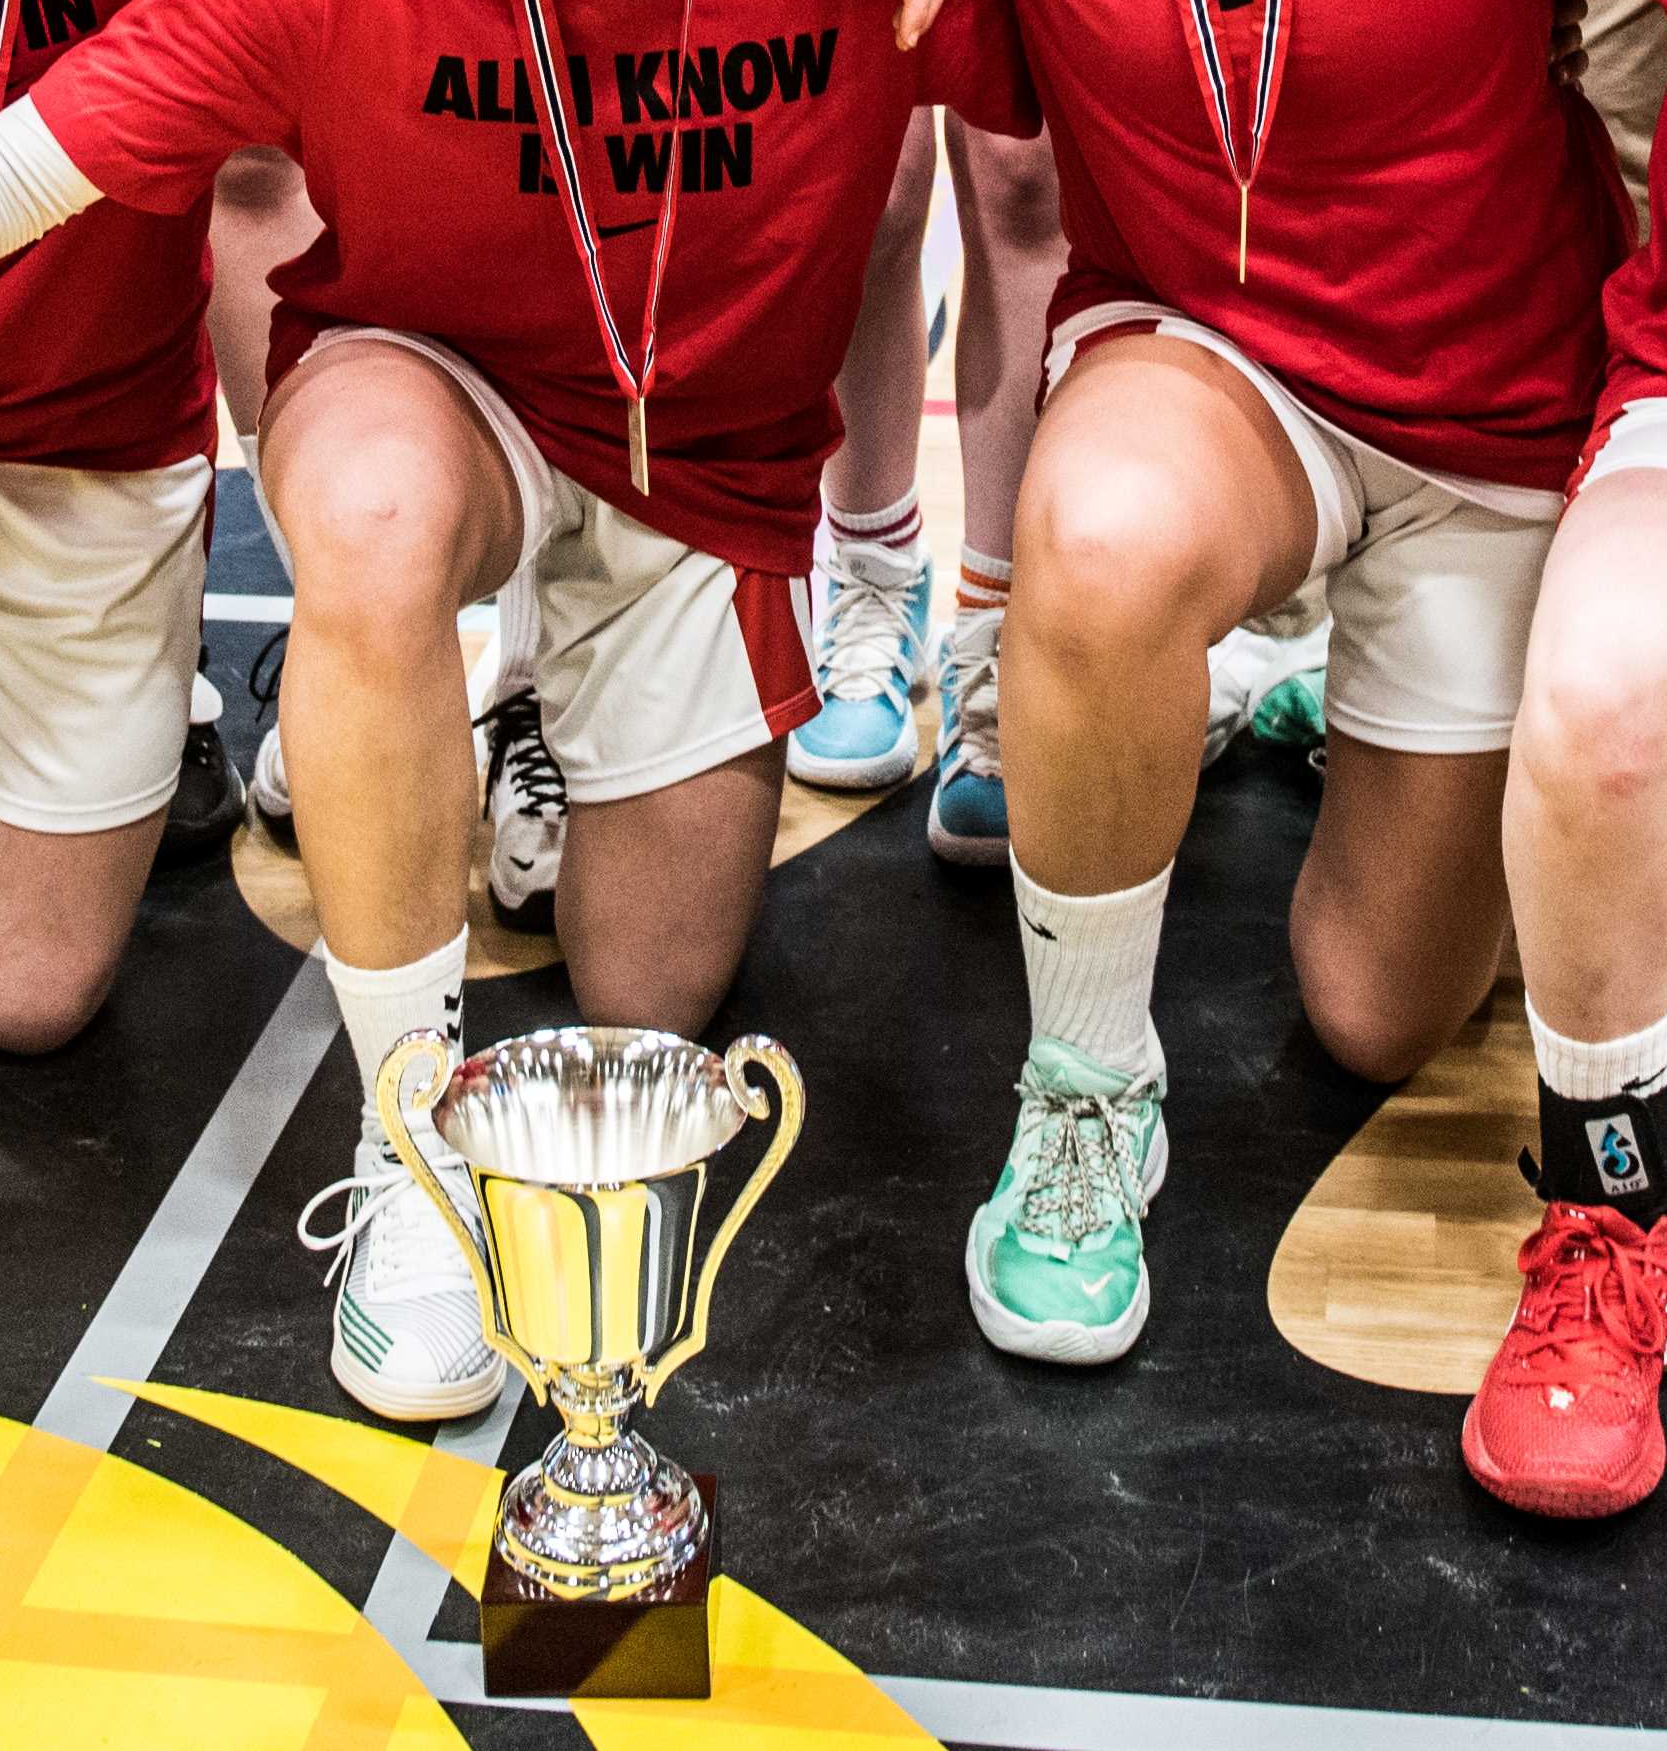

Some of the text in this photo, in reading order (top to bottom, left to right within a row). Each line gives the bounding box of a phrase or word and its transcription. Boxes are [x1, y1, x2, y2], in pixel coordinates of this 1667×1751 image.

[422, 27, 840, 127] ALL I KNOW
[604, 121, 755, 195] WIN
